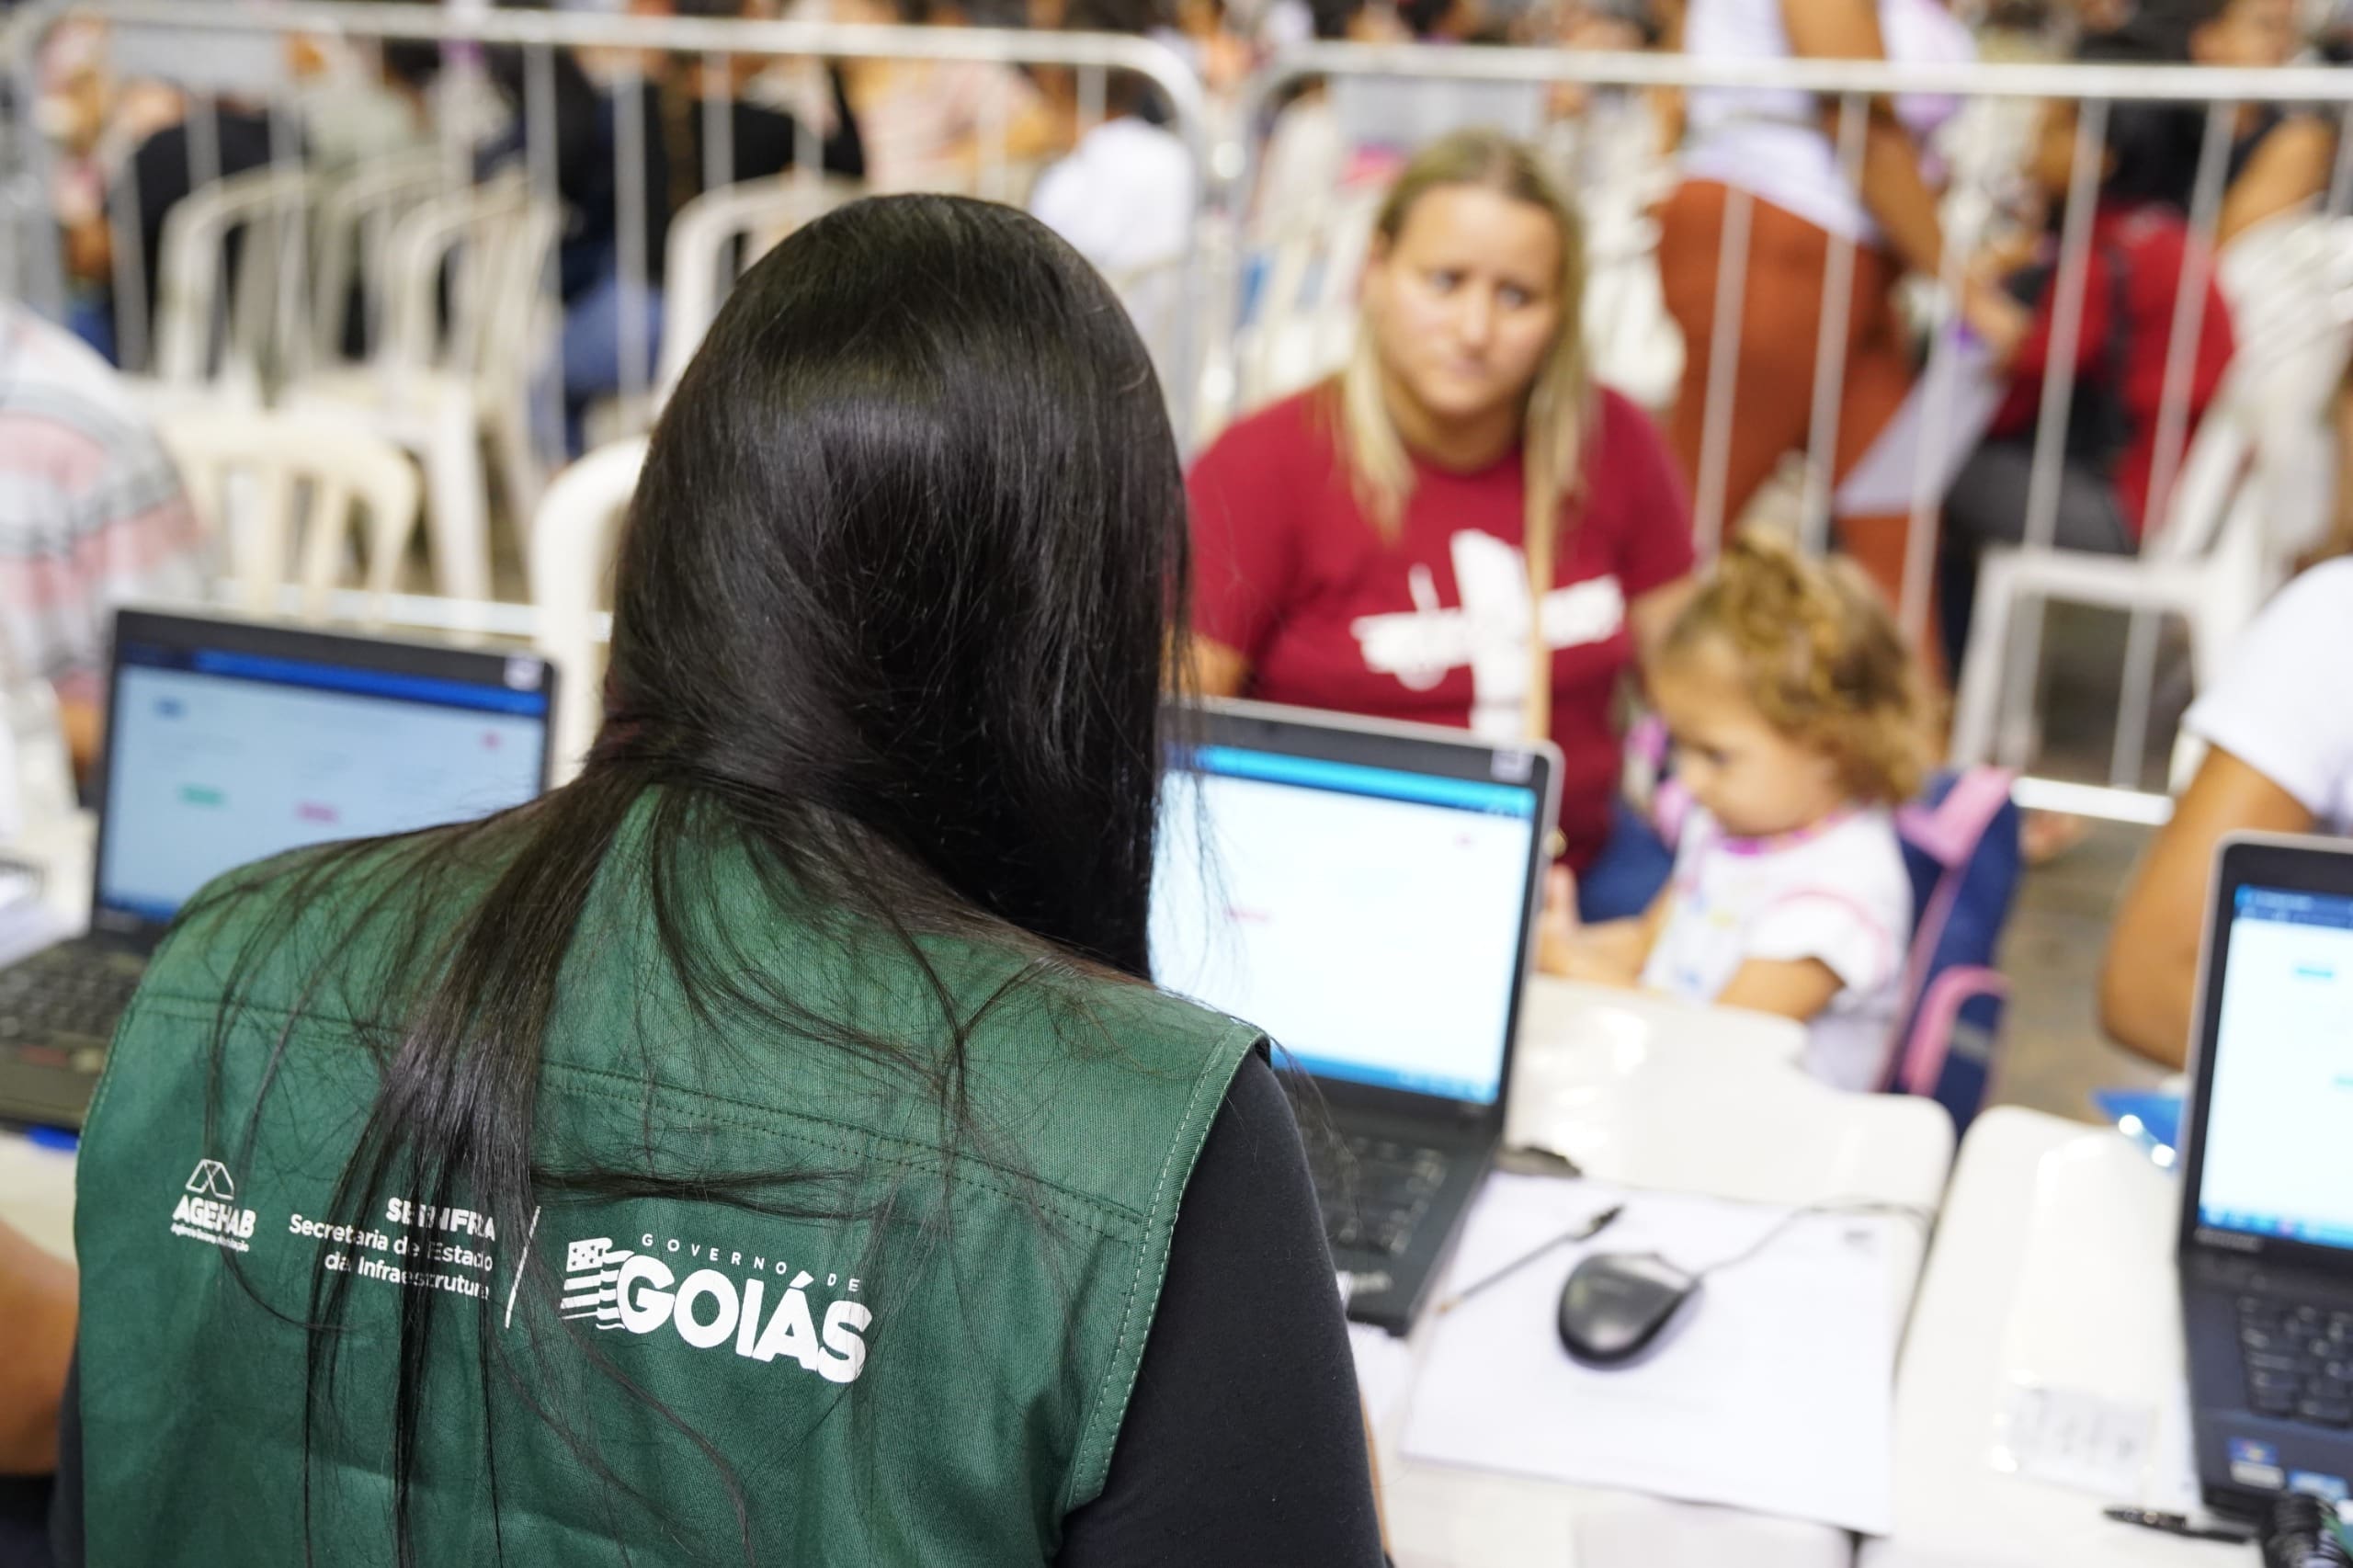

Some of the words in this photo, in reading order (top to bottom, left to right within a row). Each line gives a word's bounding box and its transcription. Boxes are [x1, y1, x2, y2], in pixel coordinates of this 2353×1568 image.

[172, 1194, 256, 1239] AGEHAB
[290, 1213, 389, 1251] Secretaria
[427, 1241, 494, 1271] Estado
[642, 1233, 787, 1274] GOVERNO
[827, 1273, 860, 1292] DE
[617, 1255, 872, 1383] GOIÁS
